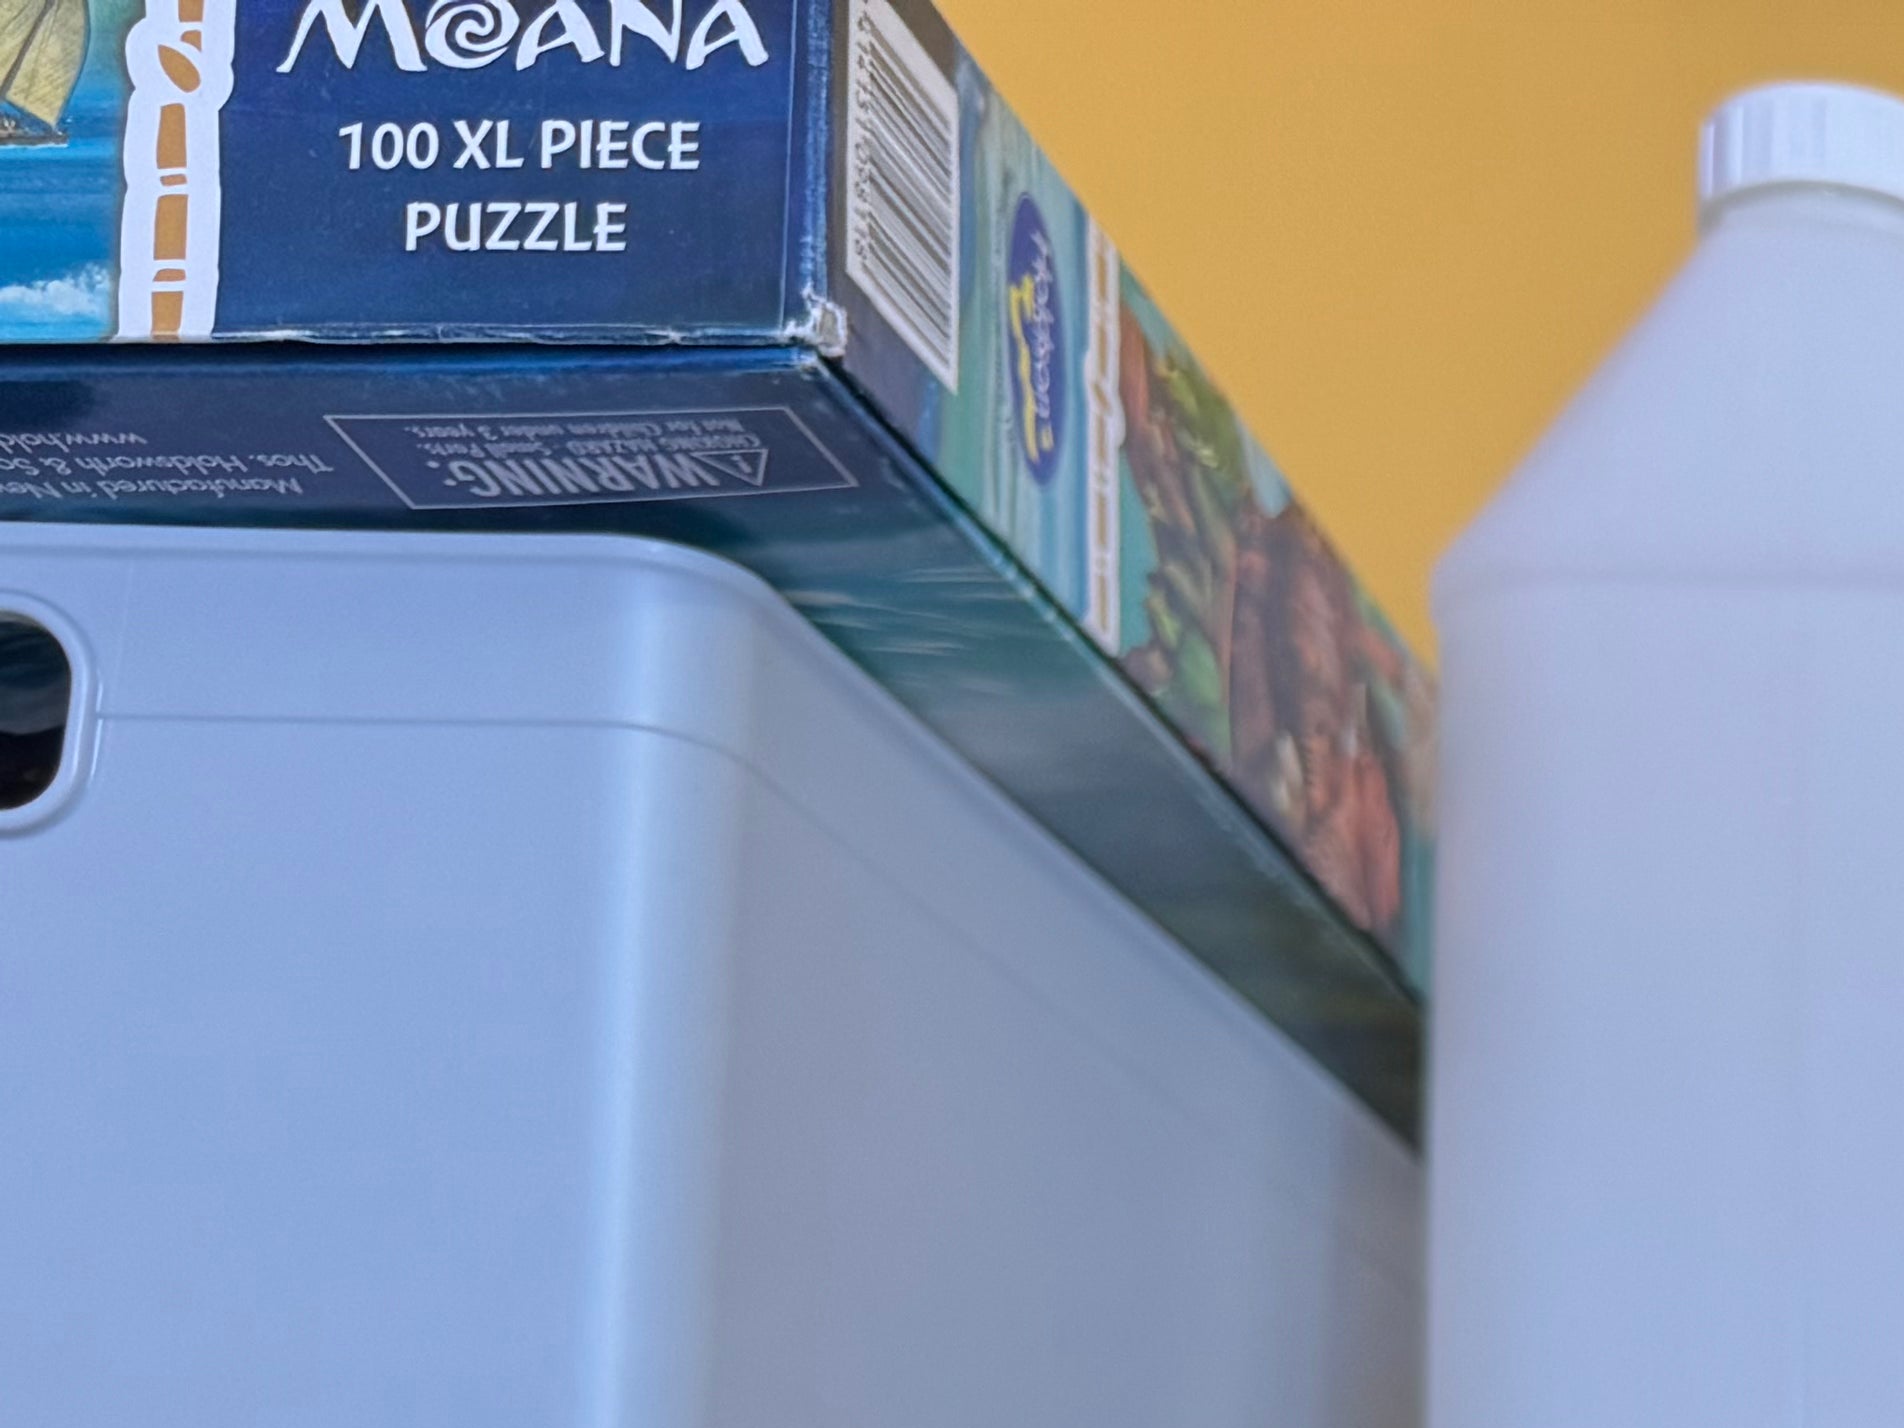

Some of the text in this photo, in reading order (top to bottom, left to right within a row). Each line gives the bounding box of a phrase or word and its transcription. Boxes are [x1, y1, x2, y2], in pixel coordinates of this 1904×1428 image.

[276, 0, 769, 72] MOANA
[338, 118, 701, 171] 100 XL PIECE
[405, 201, 628, 252] PUZZLE
[38, 456, 73, 477] &
[75, 453, 249, 477] Holdsworth
[249, 453, 334, 475] Thos.
[60, 479, 98, 499] in
[100, 475, 304, 500] Manufactured
